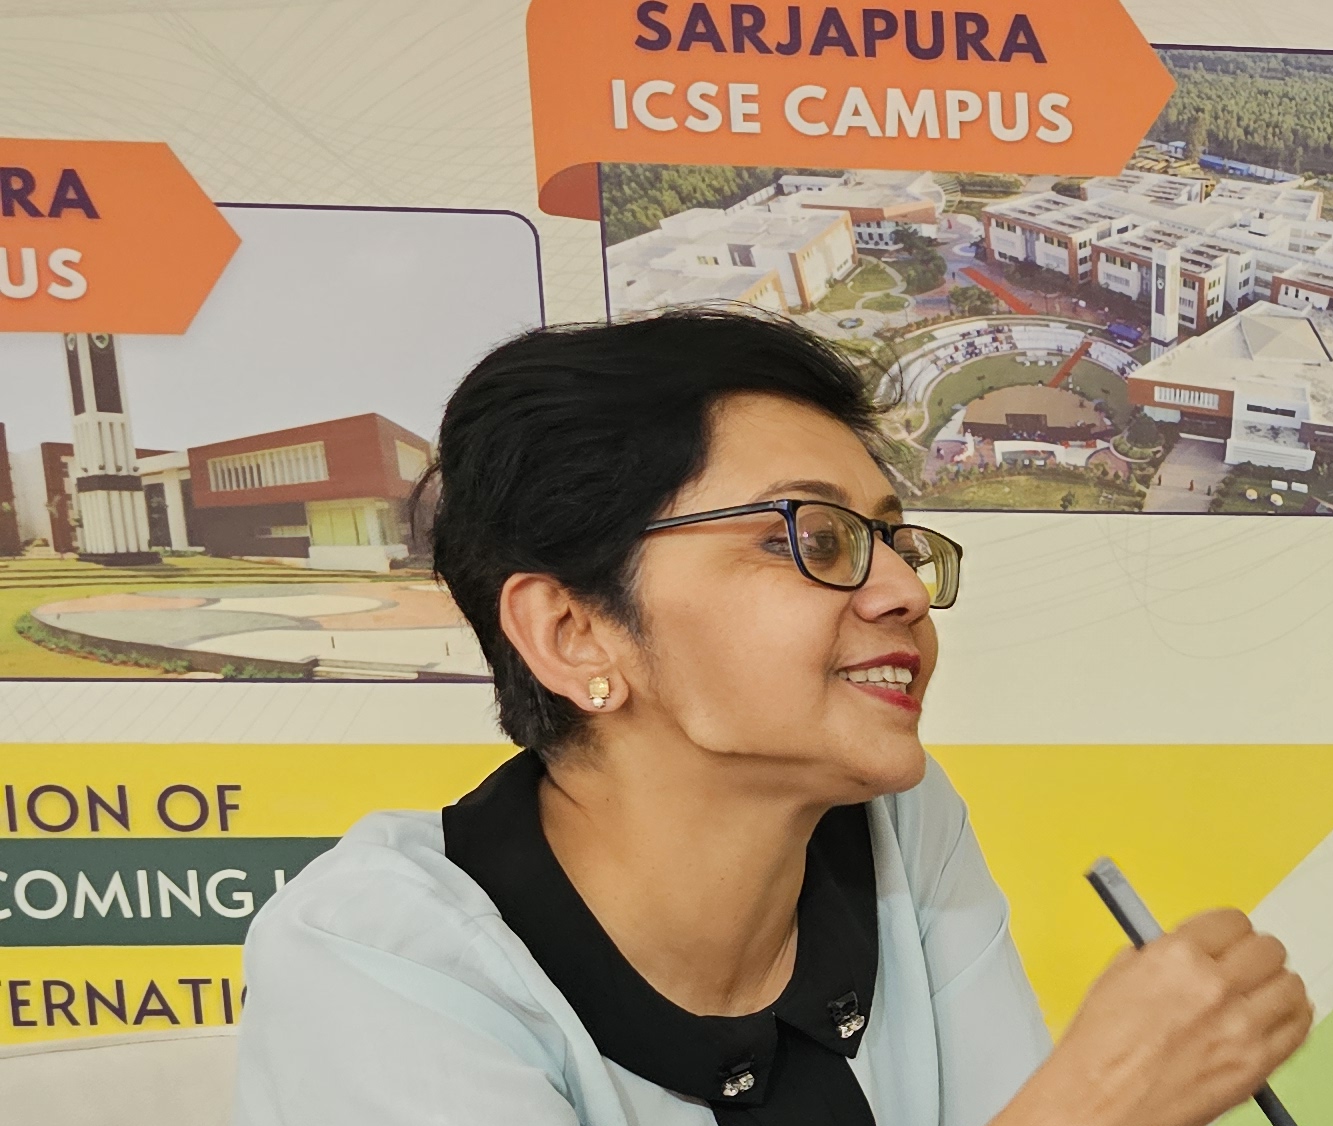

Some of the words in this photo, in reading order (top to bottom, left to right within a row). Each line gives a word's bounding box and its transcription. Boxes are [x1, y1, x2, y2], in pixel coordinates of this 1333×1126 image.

[634, 0, 1048, 64] SARJAPURA
[611, 79, 761, 134] ICSE
[784, 85, 1074, 144] CAMPUS
[0, 166, 102, 220] RA
[4, 783, 132, 833] ION
[156, 783, 243, 833] OF
[8, 977, 249, 1027] ERNATI
